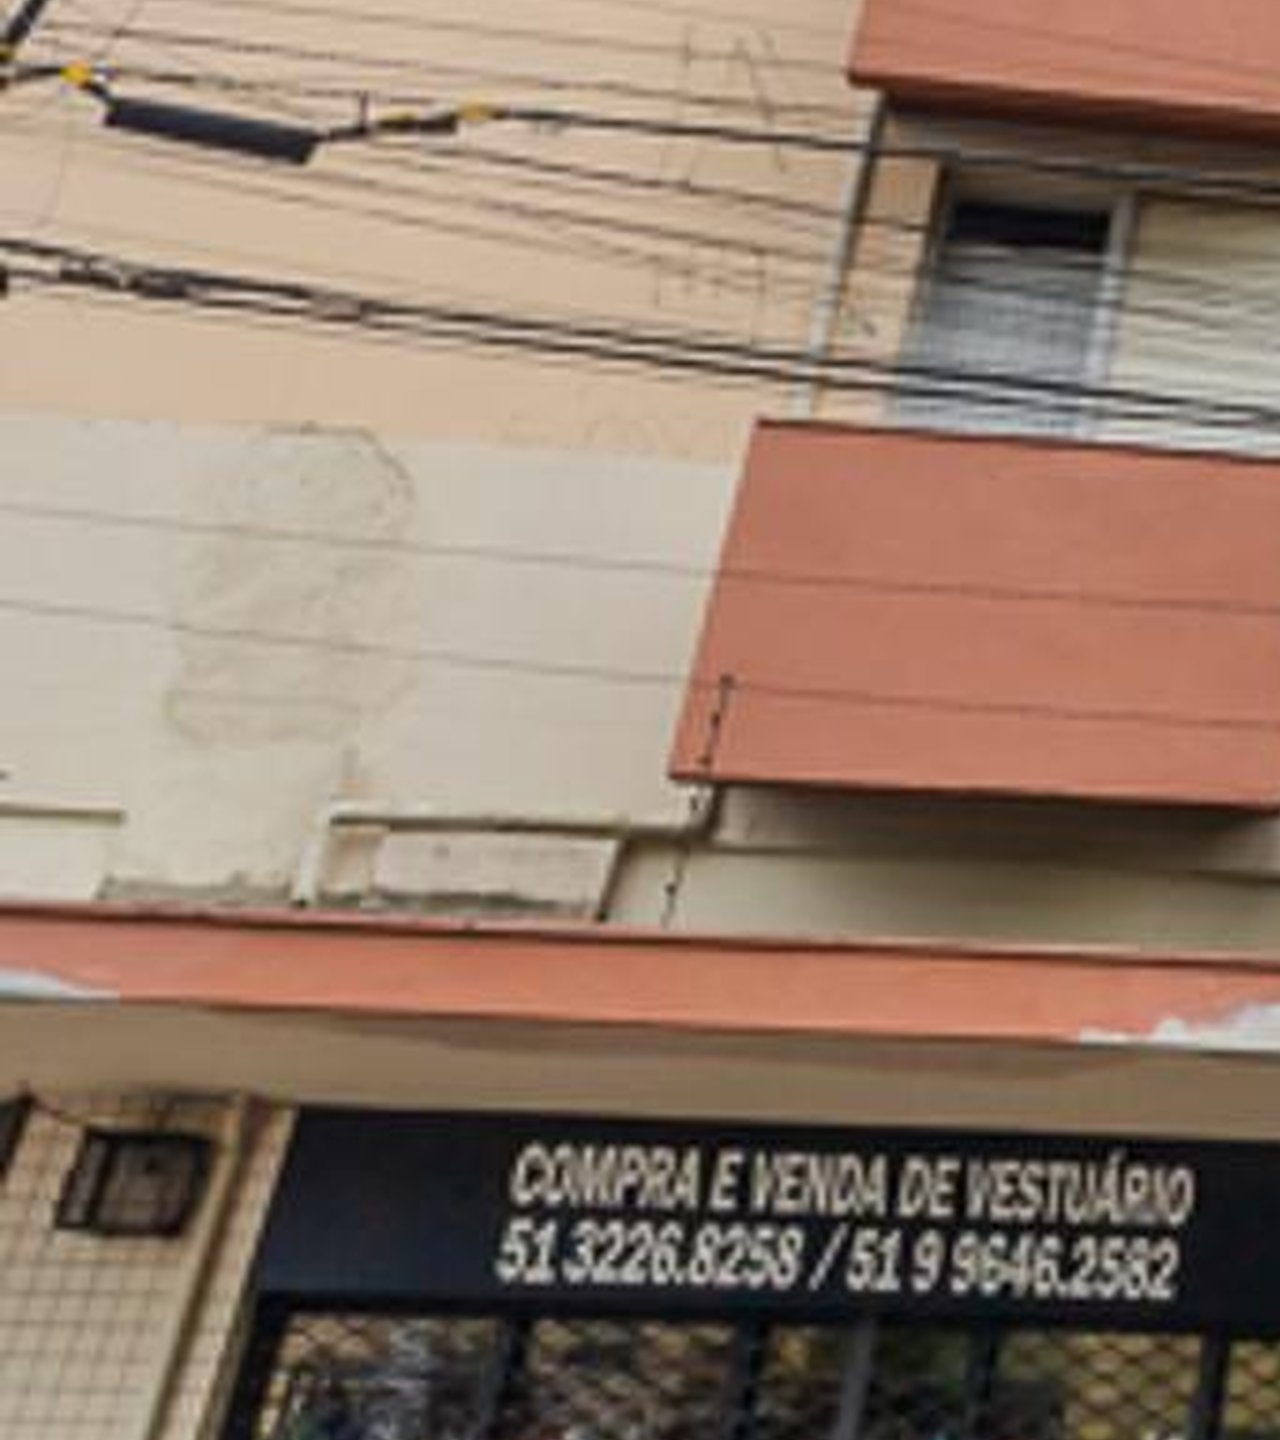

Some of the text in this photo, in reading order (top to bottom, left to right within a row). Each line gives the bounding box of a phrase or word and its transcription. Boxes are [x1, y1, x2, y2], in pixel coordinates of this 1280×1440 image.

[509, 1141, 1196, 1224] COMPRA E VENDA DE VESTUÁRIO
[495, 1218, 557, 1285] 51
[561, 1220, 805, 1291] 3226.8258
[846, 1227, 901, 1293] 51
[911, 1229, 945, 1293] 9
